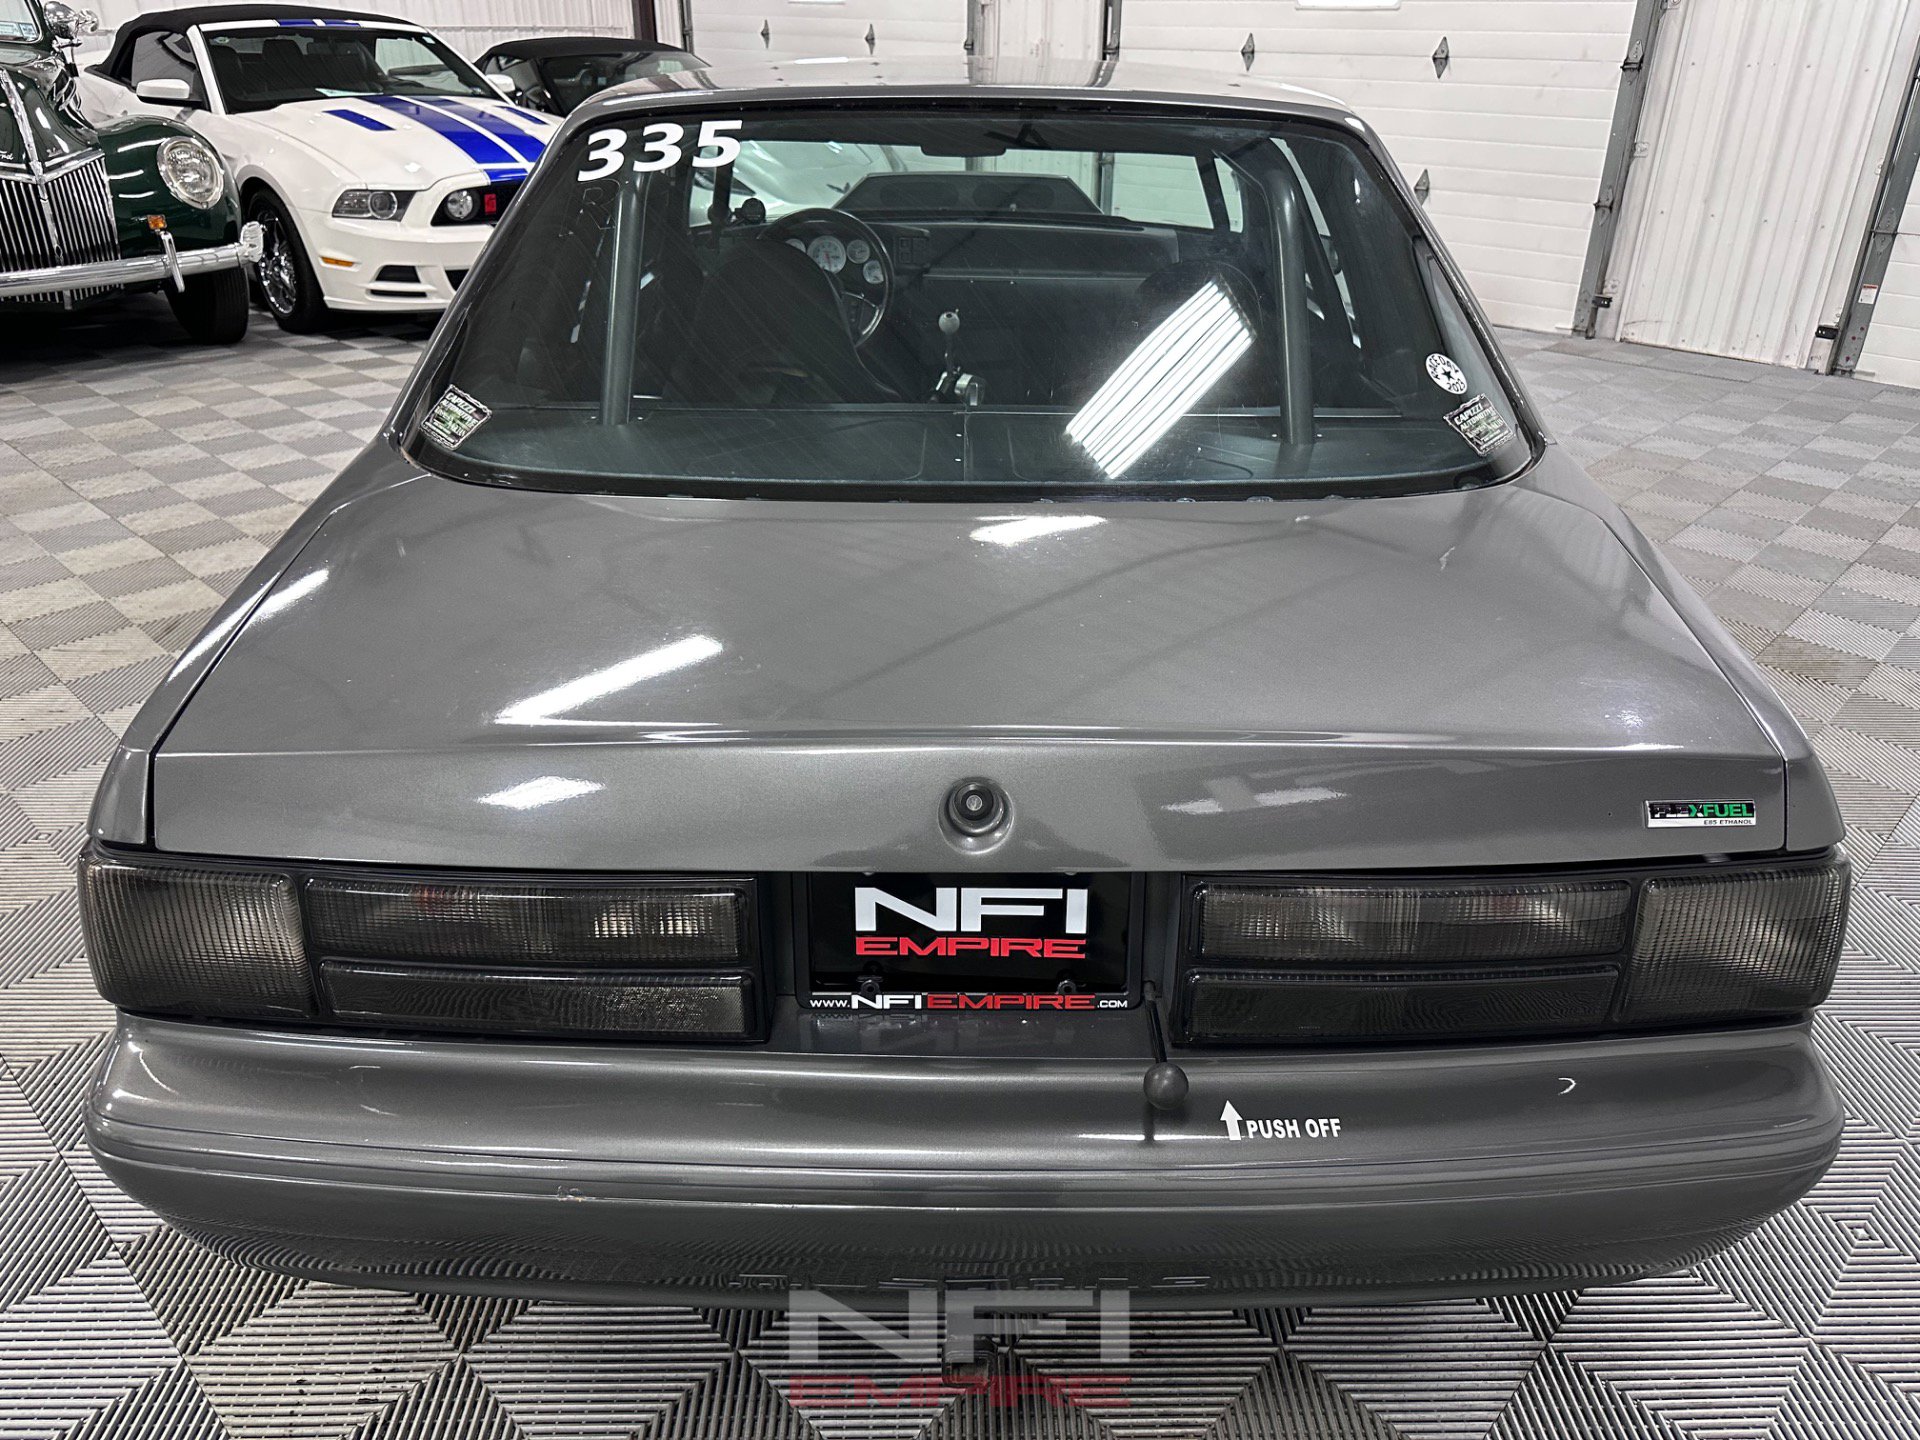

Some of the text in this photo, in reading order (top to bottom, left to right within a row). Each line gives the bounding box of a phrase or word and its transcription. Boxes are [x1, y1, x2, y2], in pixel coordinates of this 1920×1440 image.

[577, 119, 743, 182] 335
[855, 887, 1088, 934] NFI
[855, 936, 1087, 959] EMPIRE
[1245, 1118, 1342, 1139] PUSH OFF
